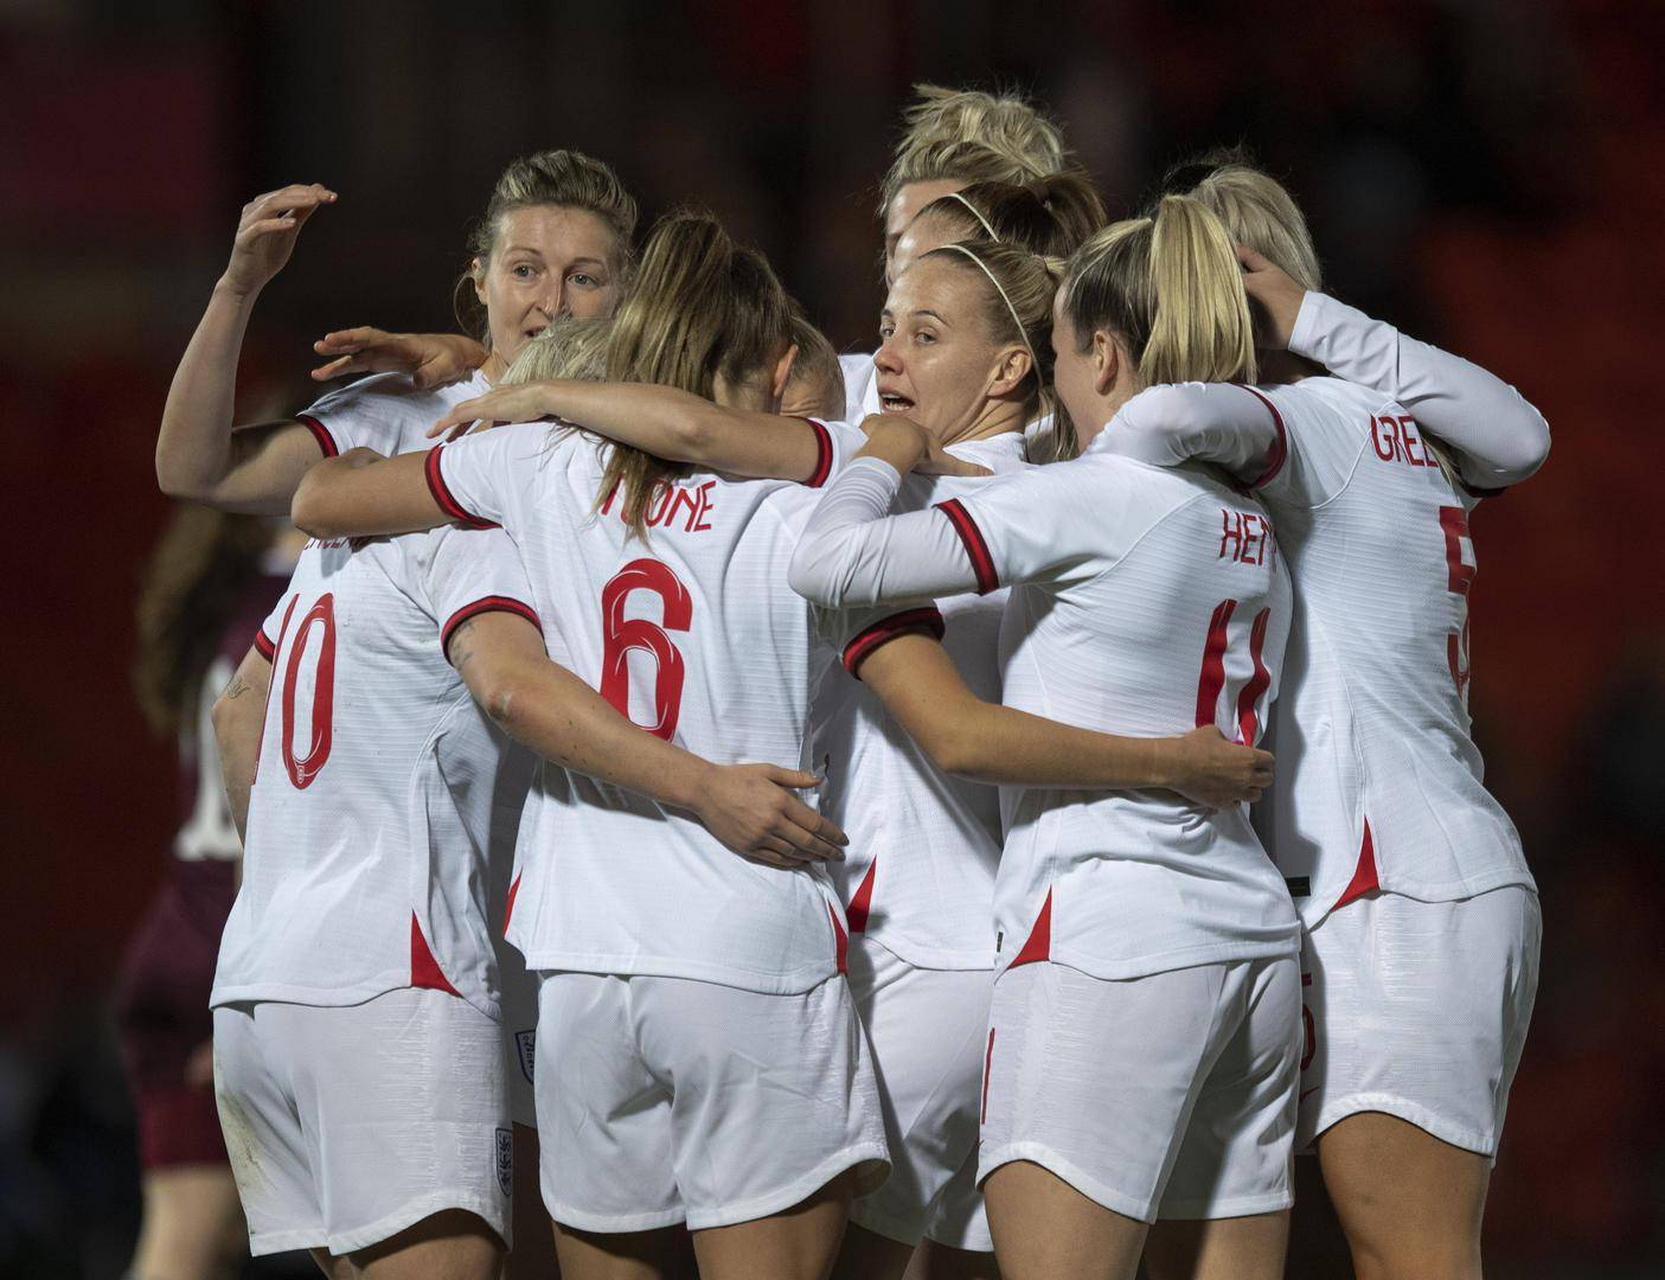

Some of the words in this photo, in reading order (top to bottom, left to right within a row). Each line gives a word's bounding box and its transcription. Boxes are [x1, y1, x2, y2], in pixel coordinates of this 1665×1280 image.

[601, 472, 716, 532] ONE
[601, 557, 693, 743] 6
[1195, 598, 1271, 748] 11
